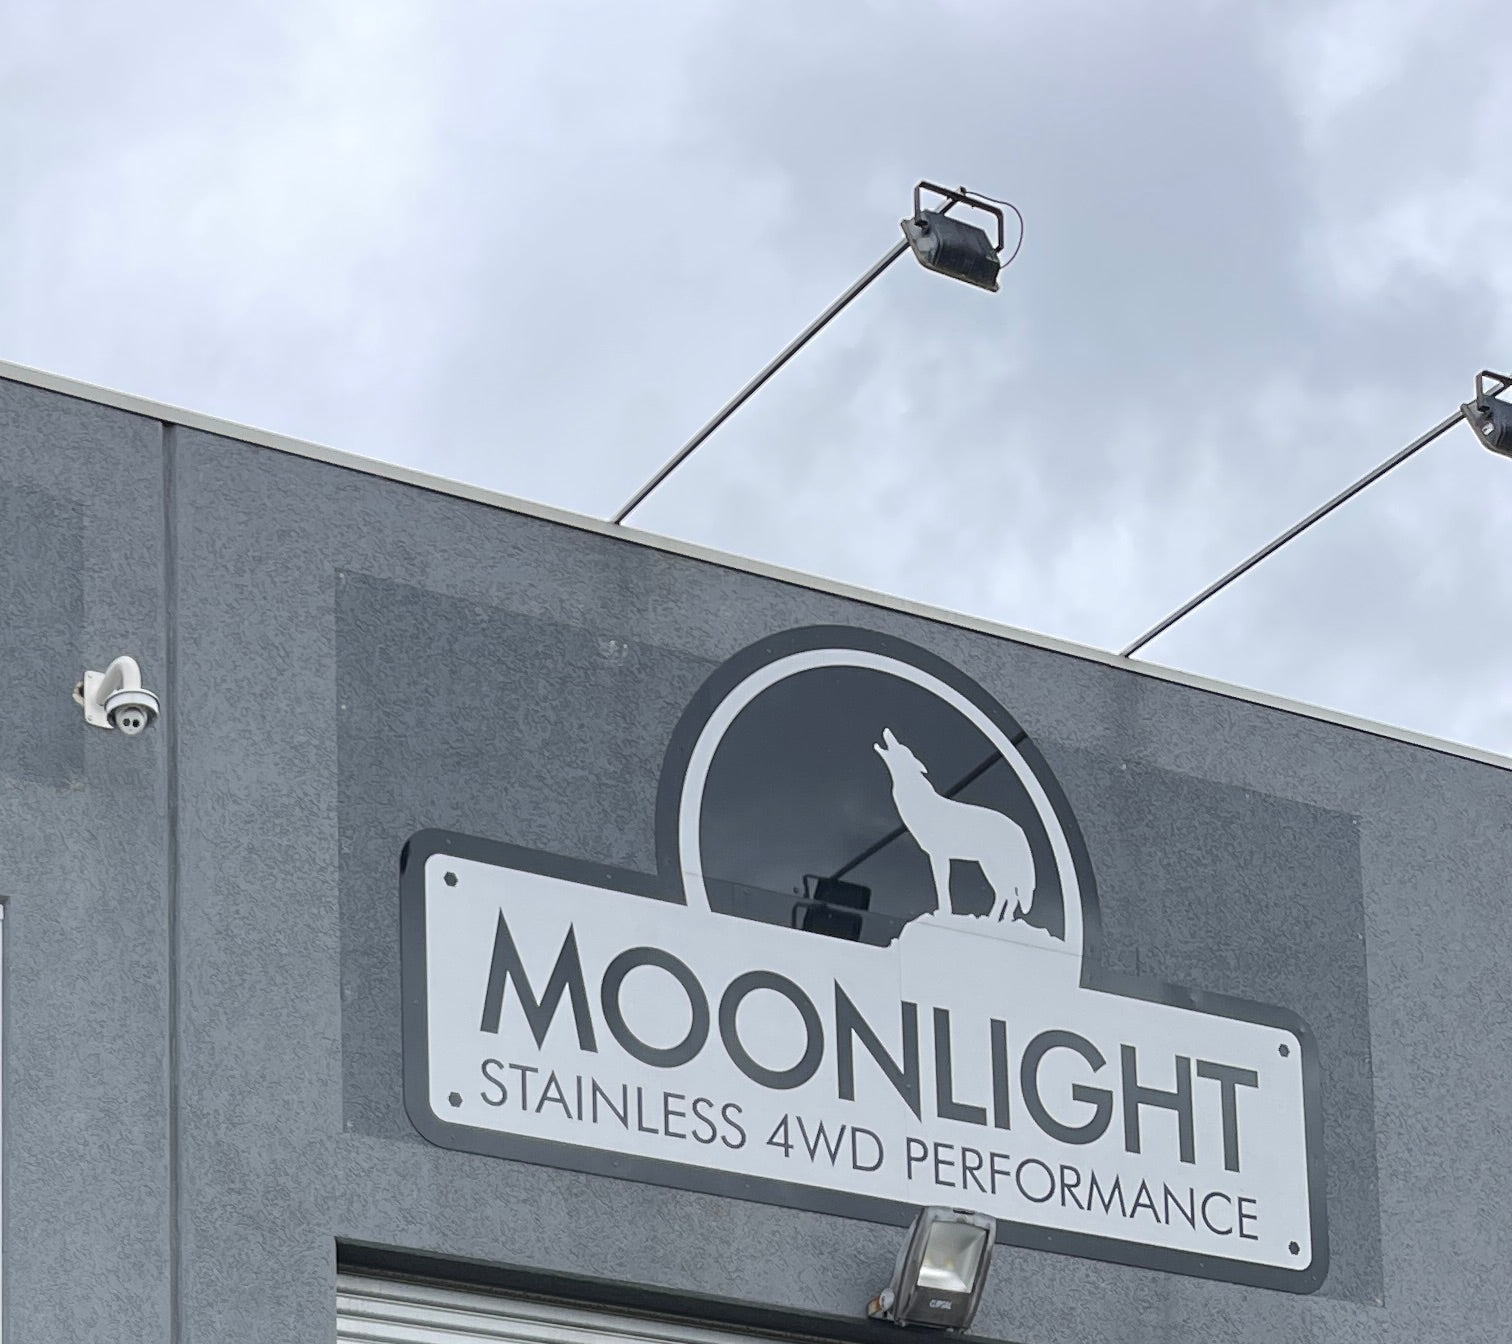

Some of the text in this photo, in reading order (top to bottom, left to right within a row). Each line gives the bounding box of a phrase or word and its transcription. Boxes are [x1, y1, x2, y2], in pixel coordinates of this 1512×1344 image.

[480, 906, 1259, 1173] MOONLIGHT
[480, 1058, 1259, 1241] STAINLESS 4WD PERFORMANCE
